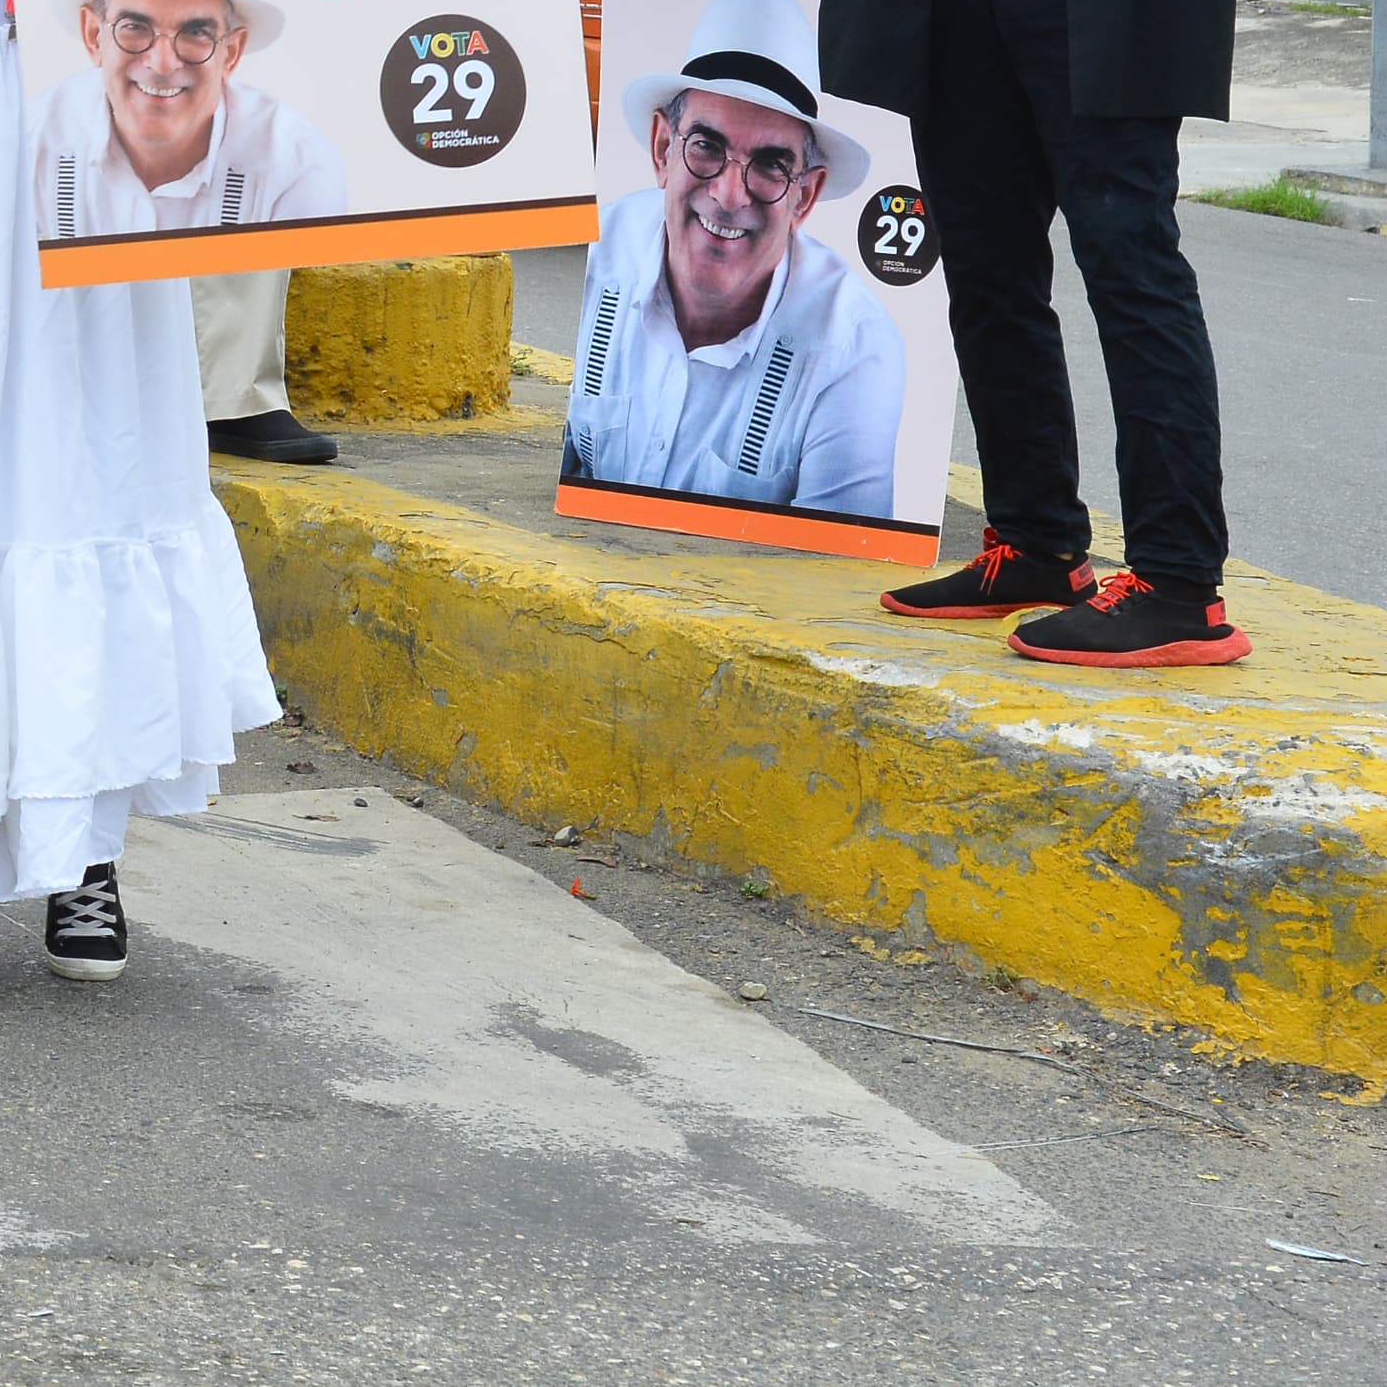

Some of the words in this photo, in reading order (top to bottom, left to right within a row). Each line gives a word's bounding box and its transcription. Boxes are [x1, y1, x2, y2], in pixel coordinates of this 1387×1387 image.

[409, 31, 489, 59] VOTA
[410, 60, 495, 124] 29
[431, 129, 468, 140] OPCIÓN
[432, 135, 499, 149] DEMOCRÁTICA
[879, 195, 925, 215] VOTA
[874, 215, 925, 256] 29
